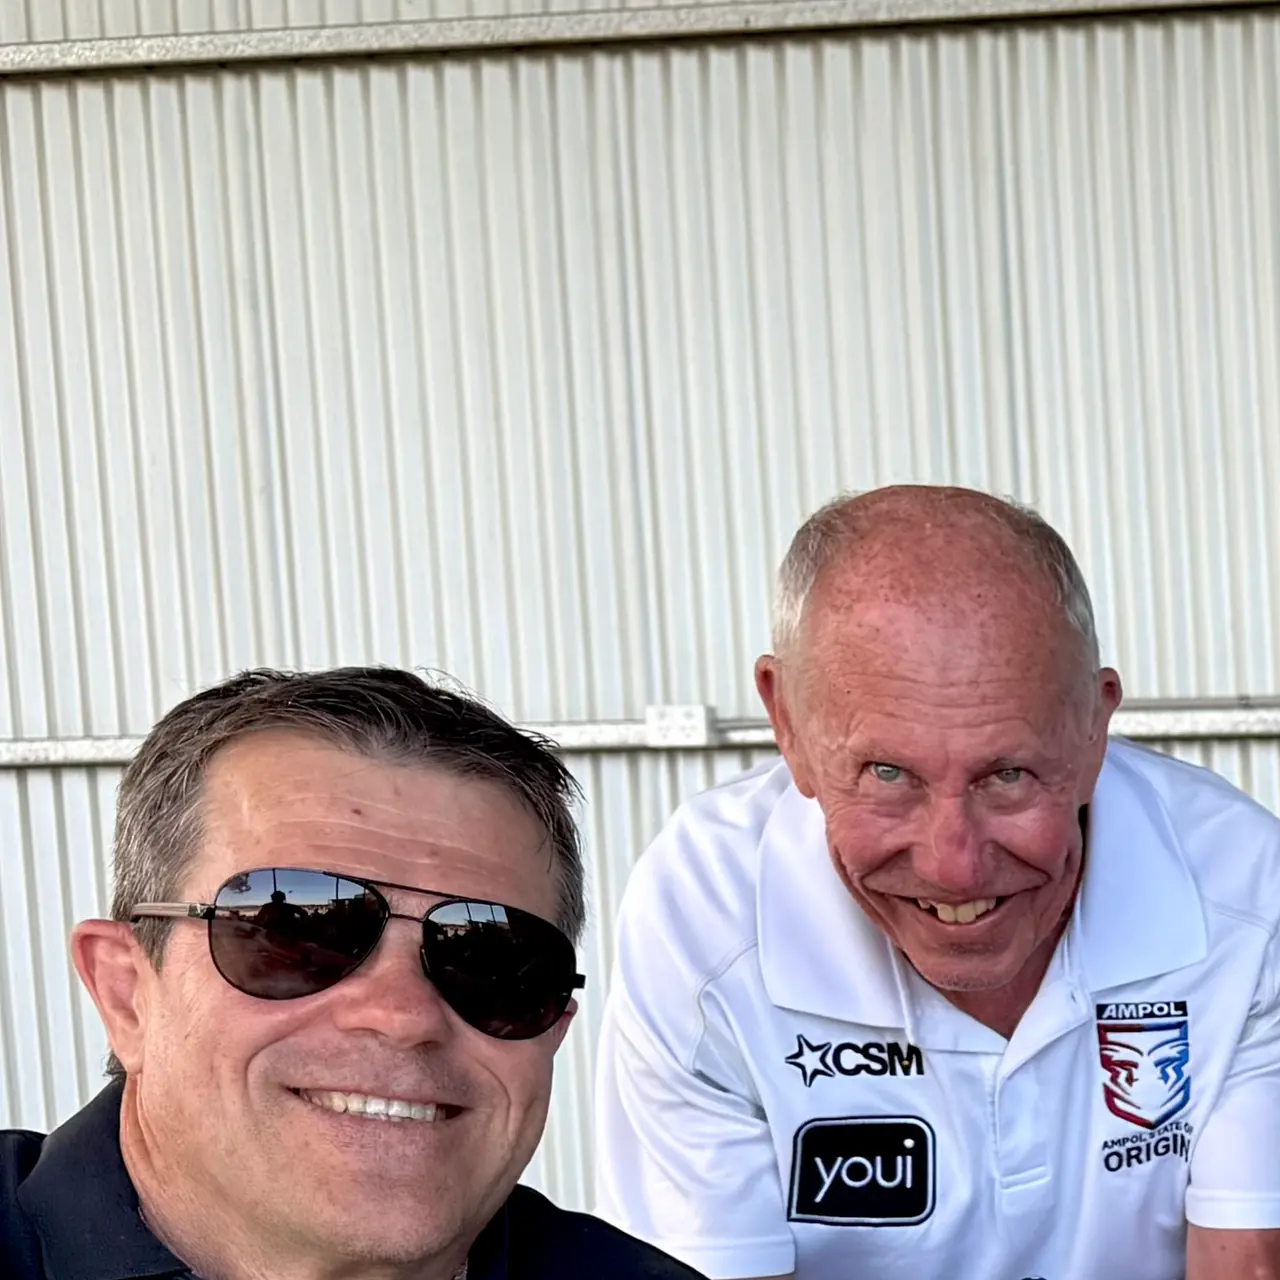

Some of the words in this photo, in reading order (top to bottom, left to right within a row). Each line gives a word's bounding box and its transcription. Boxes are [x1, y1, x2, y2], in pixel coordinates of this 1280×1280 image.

[1102, 1001, 1184, 1020] AMPOL
[832, 1042, 925, 1077] CSM
[1102, 1134, 1147, 1151] AMPOL
[1104, 1133, 1190, 1172] ORIGIN
[814, 1137, 914, 1203] youi
